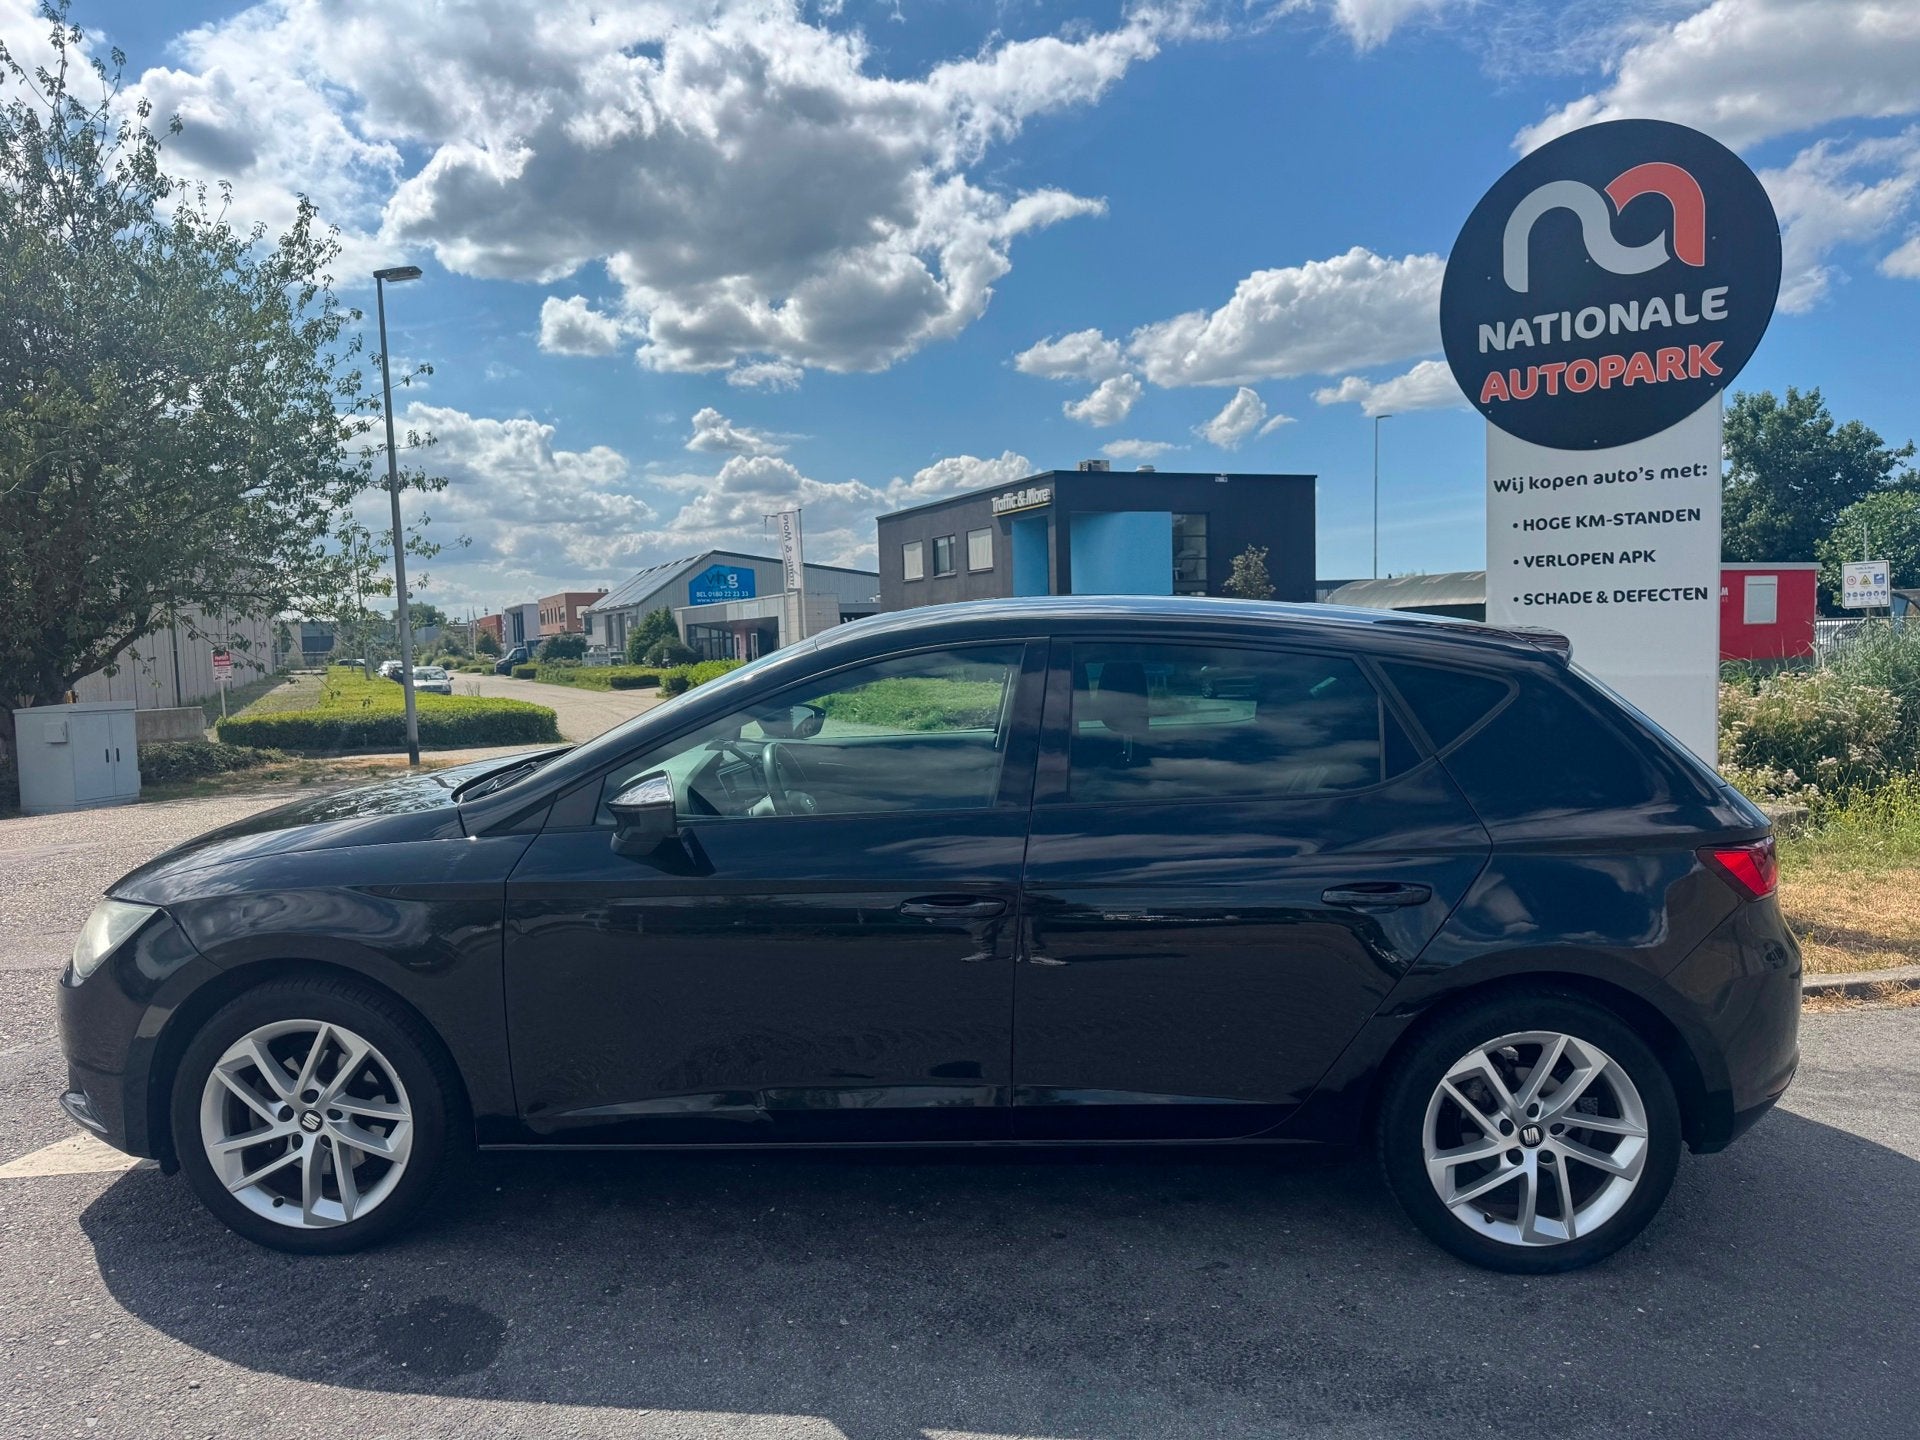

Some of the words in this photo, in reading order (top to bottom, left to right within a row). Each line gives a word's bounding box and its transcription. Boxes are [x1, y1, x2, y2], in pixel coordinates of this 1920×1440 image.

[1478, 286, 1729, 353] NATIONALE
[1480, 340, 1724, 404] AUTOPARK
[1494, 476, 1524, 494] Wij
[1529, 474, 1588, 491] kopen
[1593, 466, 1655, 485] auto's
[1660, 463, 1708, 480] met:
[991, 492, 1018, 513] Traffic
[1018, 491, 1026, 507] &
[1523, 516, 1571, 531] HOGE
[1576, 508, 1701, 528] KM-STANDEN
[1523, 551, 1614, 568] VERLOPEN
[1619, 549, 1657, 564] APK
[705, 570, 739, 588] vhg
[1523, 591, 1593, 606] SCHADE
[1596, 590, 1609, 604] &
[1613, 587, 1708, 603] DEFECTEN
